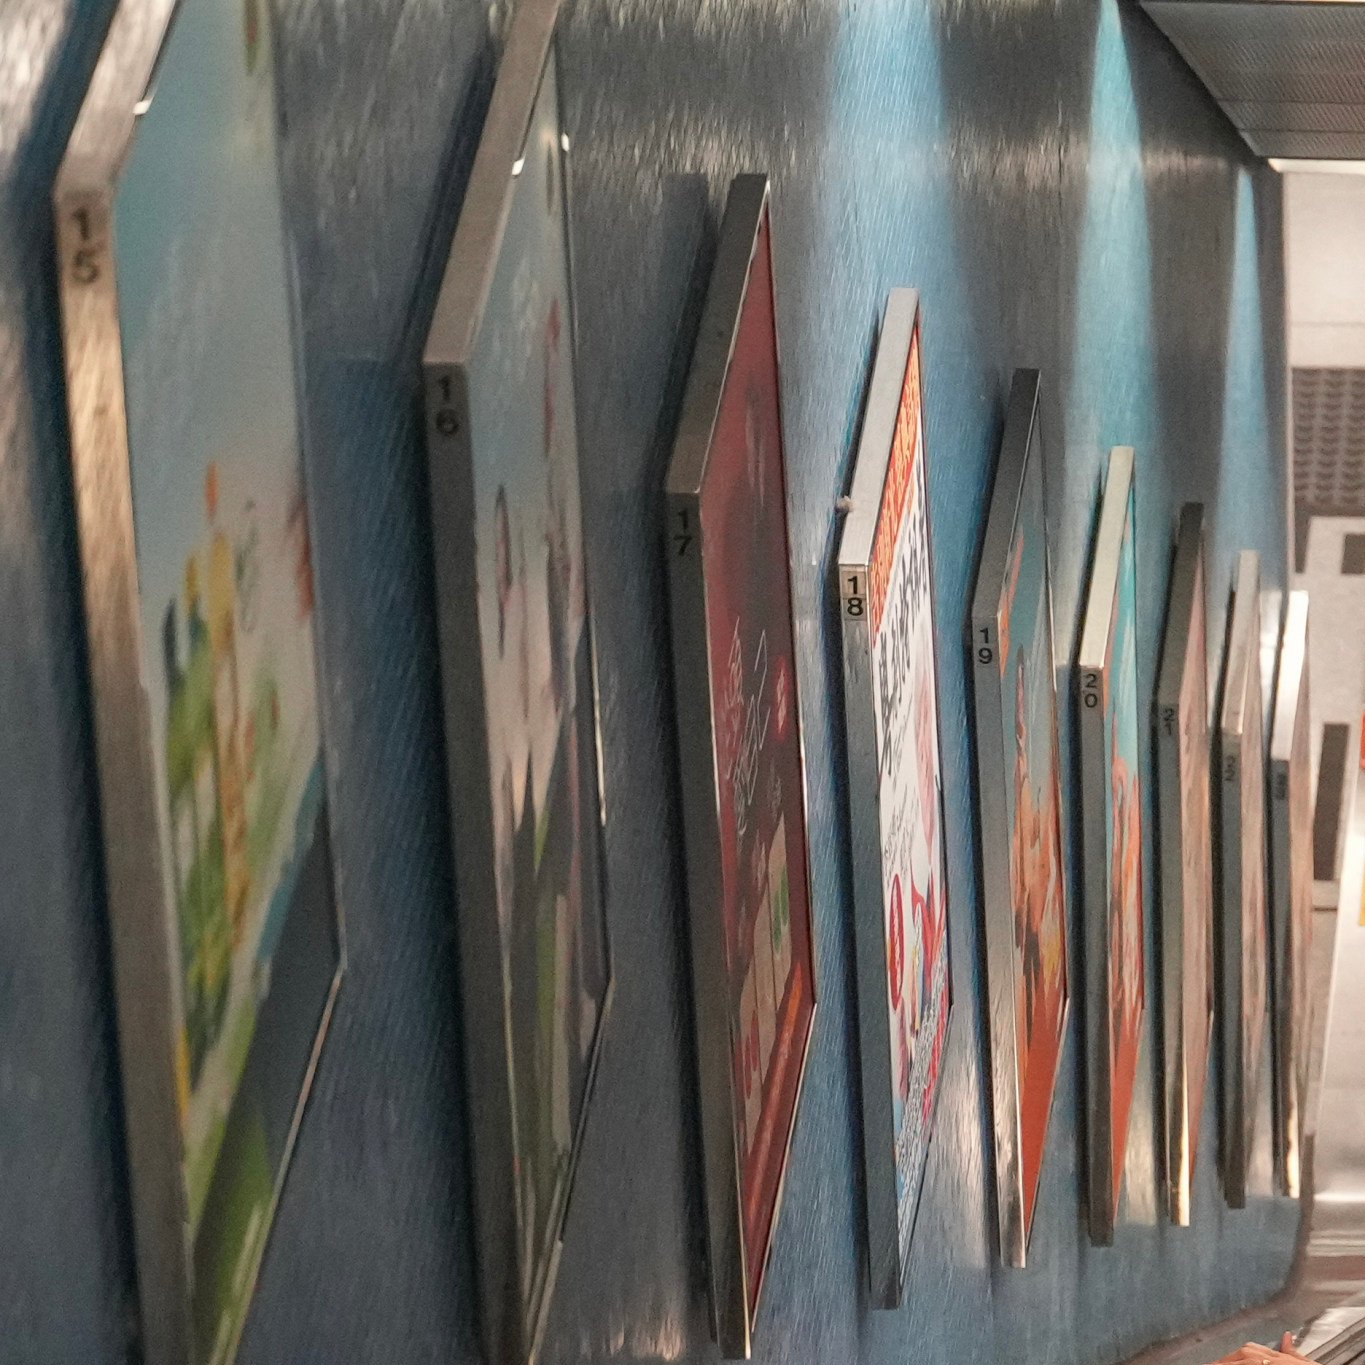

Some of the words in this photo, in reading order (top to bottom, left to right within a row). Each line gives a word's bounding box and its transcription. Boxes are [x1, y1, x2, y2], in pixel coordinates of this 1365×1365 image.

[72, 206, 100, 284] 15
[436, 374, 460, 434] 16
[673, 508, 693, 557] 17
[847, 575, 864, 616] 18
[979, 627, 993, 664] 19
[1085, 673, 1098, 708] 20
[1163, 708, 1175, 736] 21
